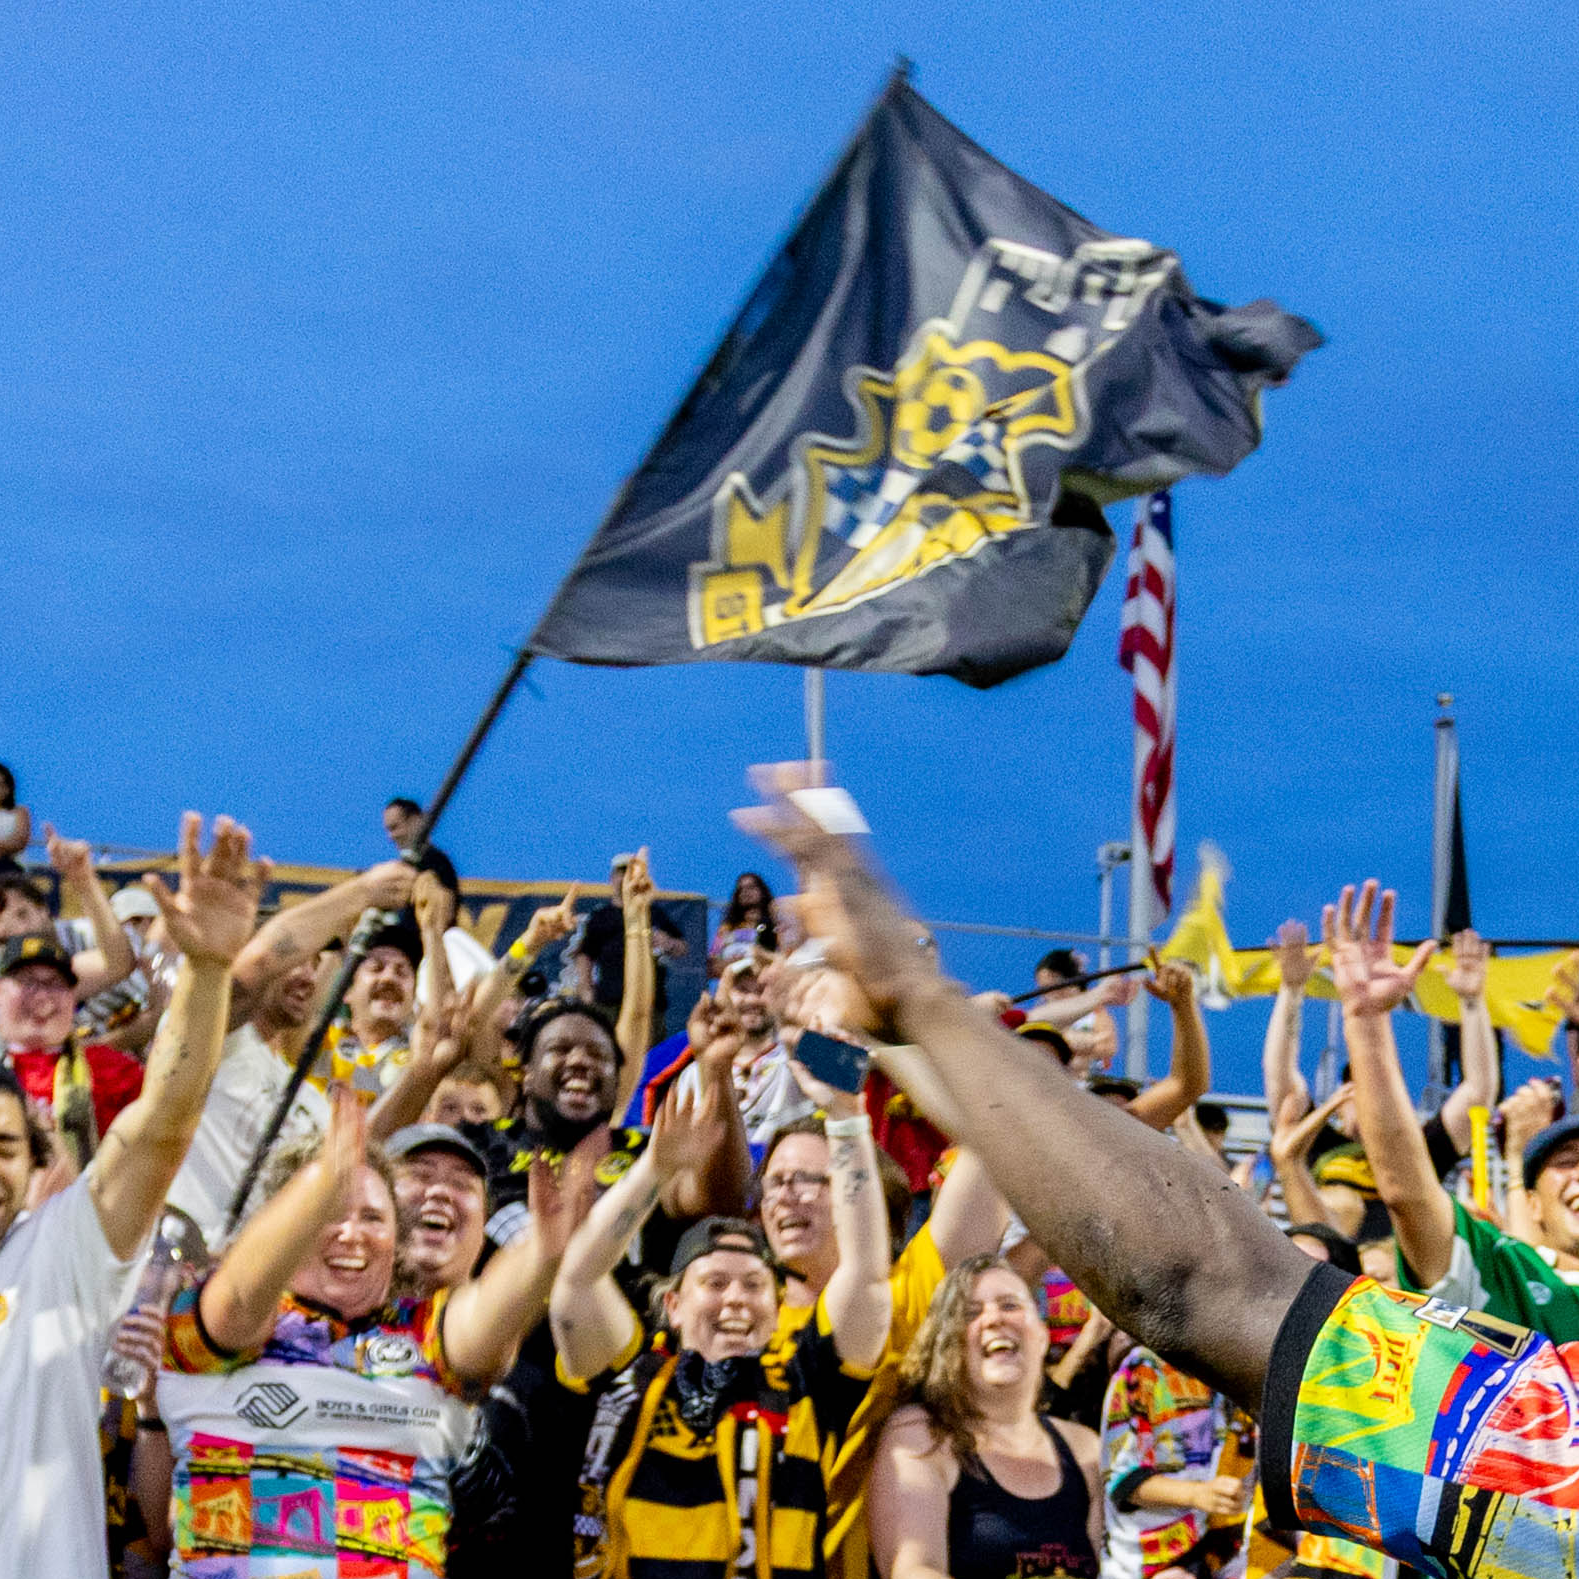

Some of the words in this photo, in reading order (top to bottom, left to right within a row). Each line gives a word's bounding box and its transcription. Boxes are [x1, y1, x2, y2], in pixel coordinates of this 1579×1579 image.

[316, 1399, 352, 1412] BOYS
[356, 1402, 366, 1413] &
[370, 1403, 408, 1417] GIRLS
